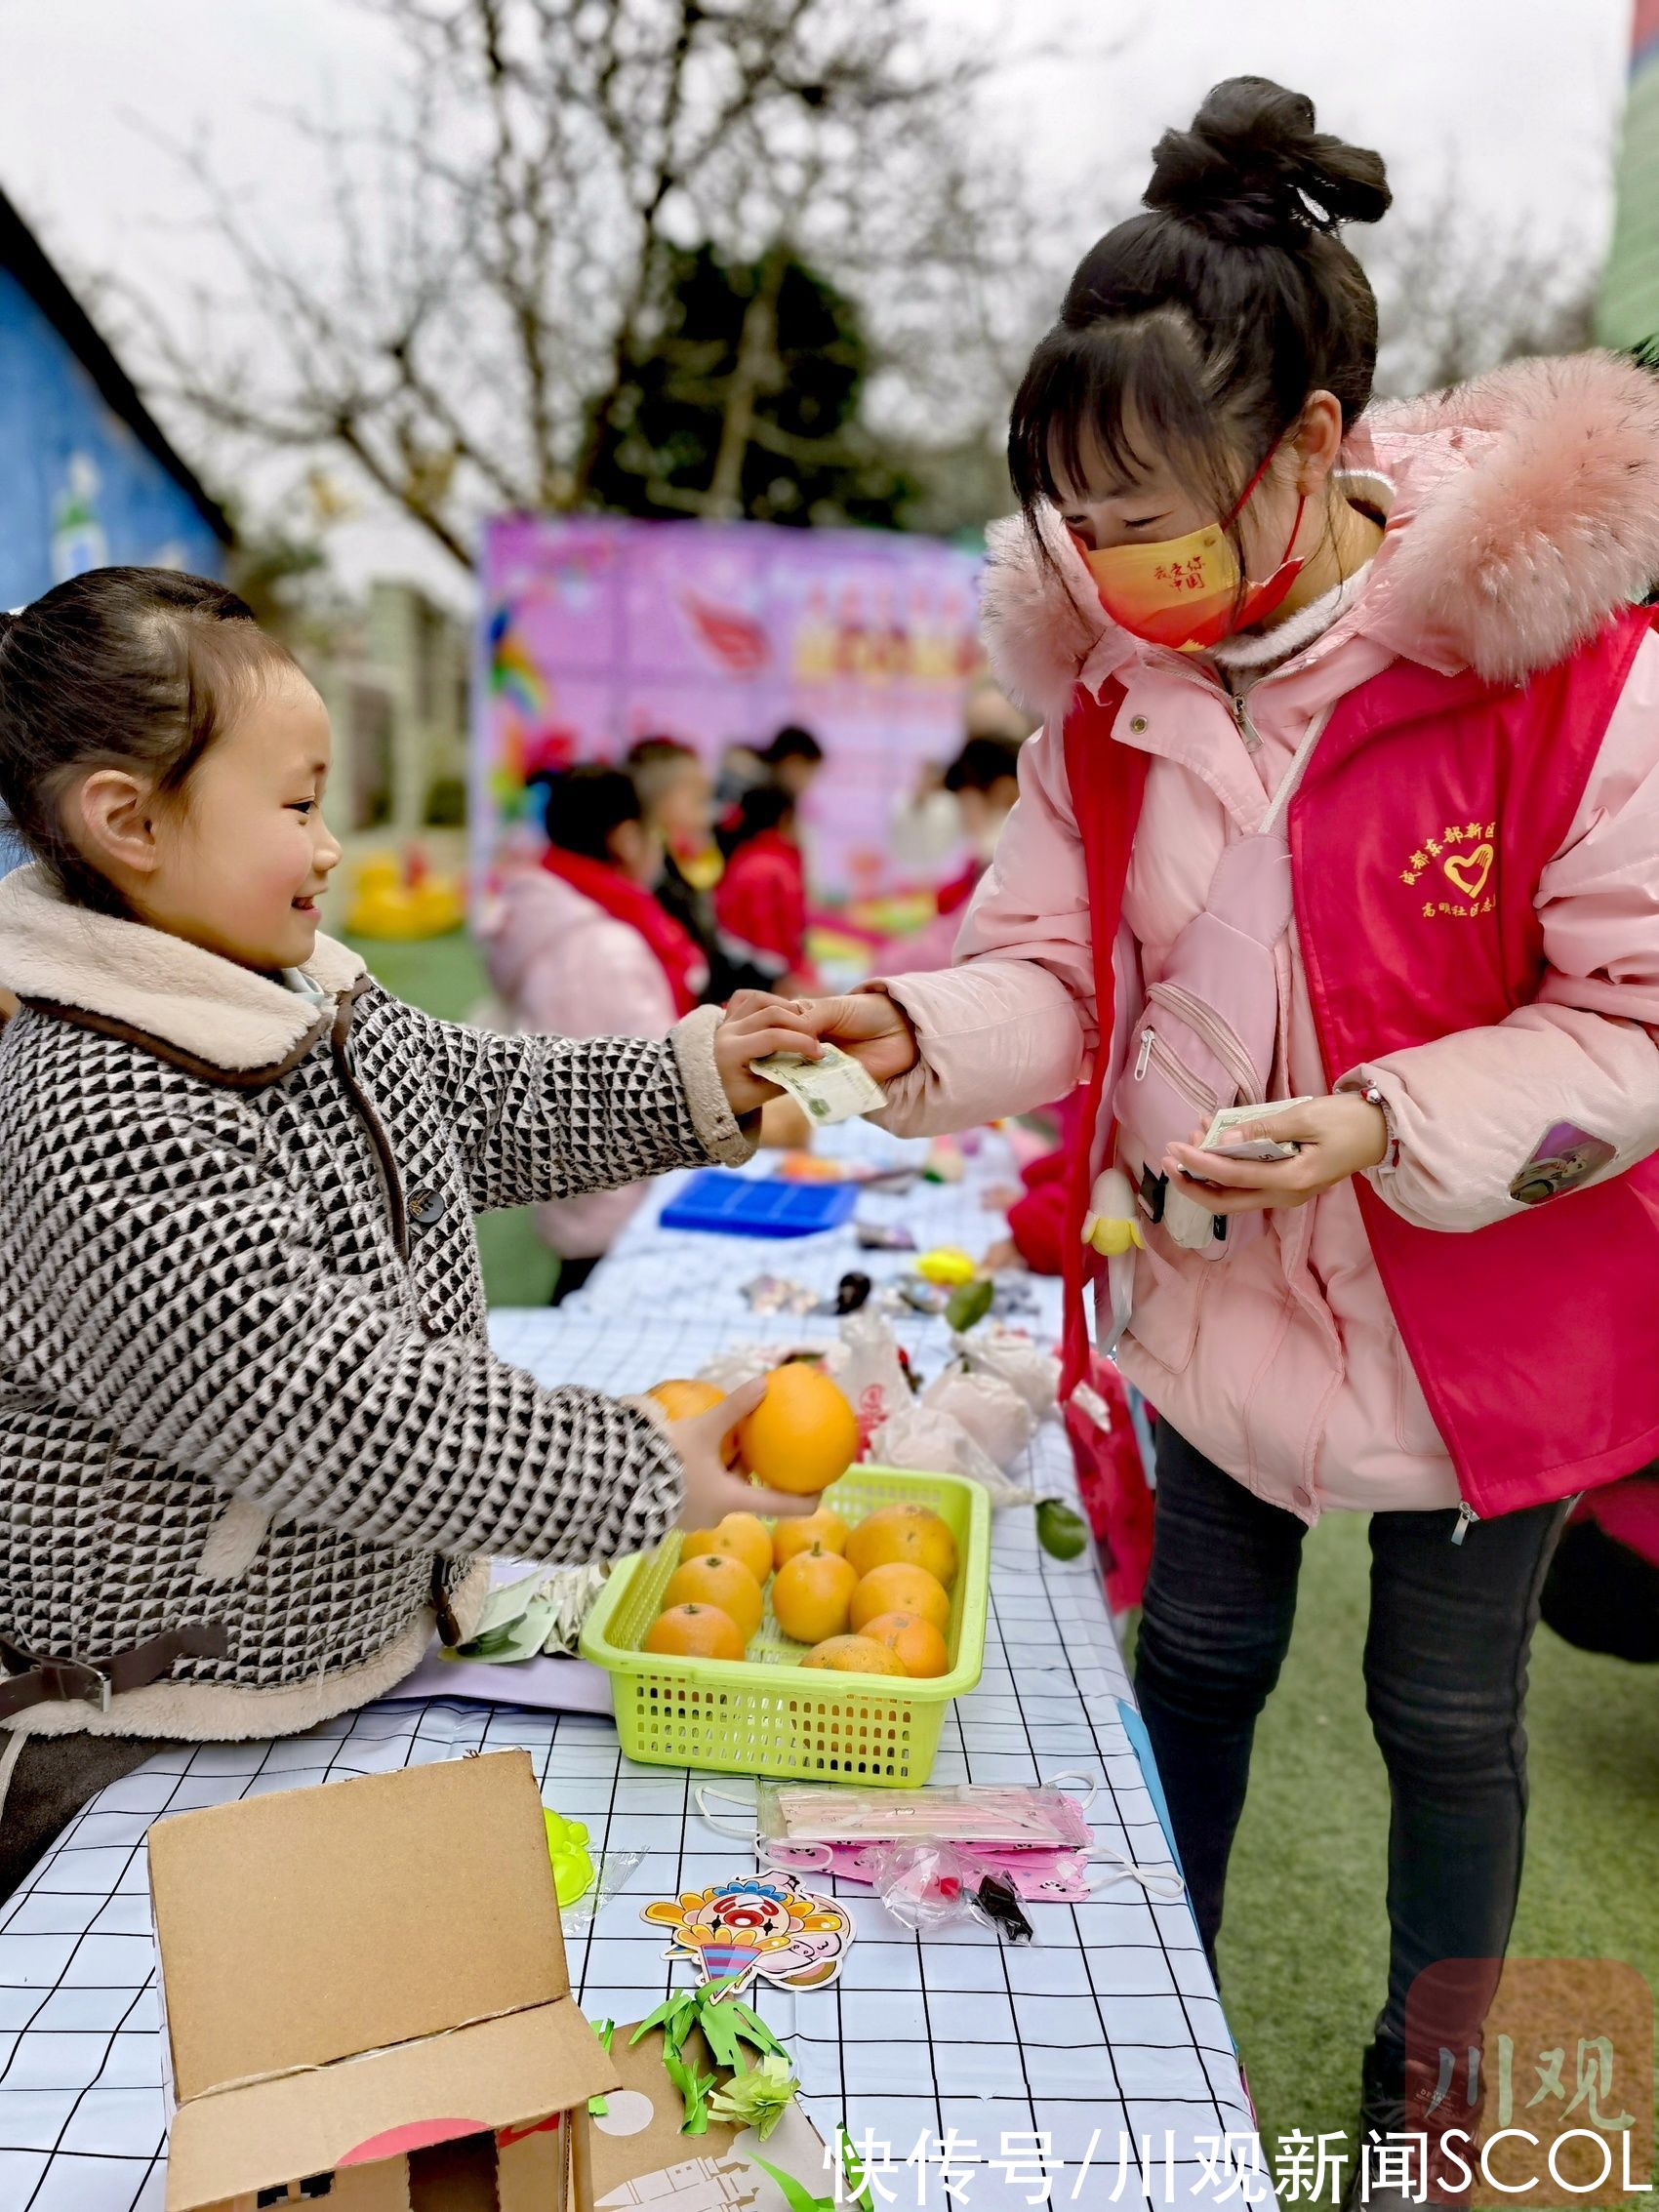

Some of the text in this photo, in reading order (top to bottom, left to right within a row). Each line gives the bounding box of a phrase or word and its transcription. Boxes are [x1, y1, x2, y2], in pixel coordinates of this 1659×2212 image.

[1153, 555, 1205, 580] 我爱你
[1169, 572, 1205, 592] 中国
